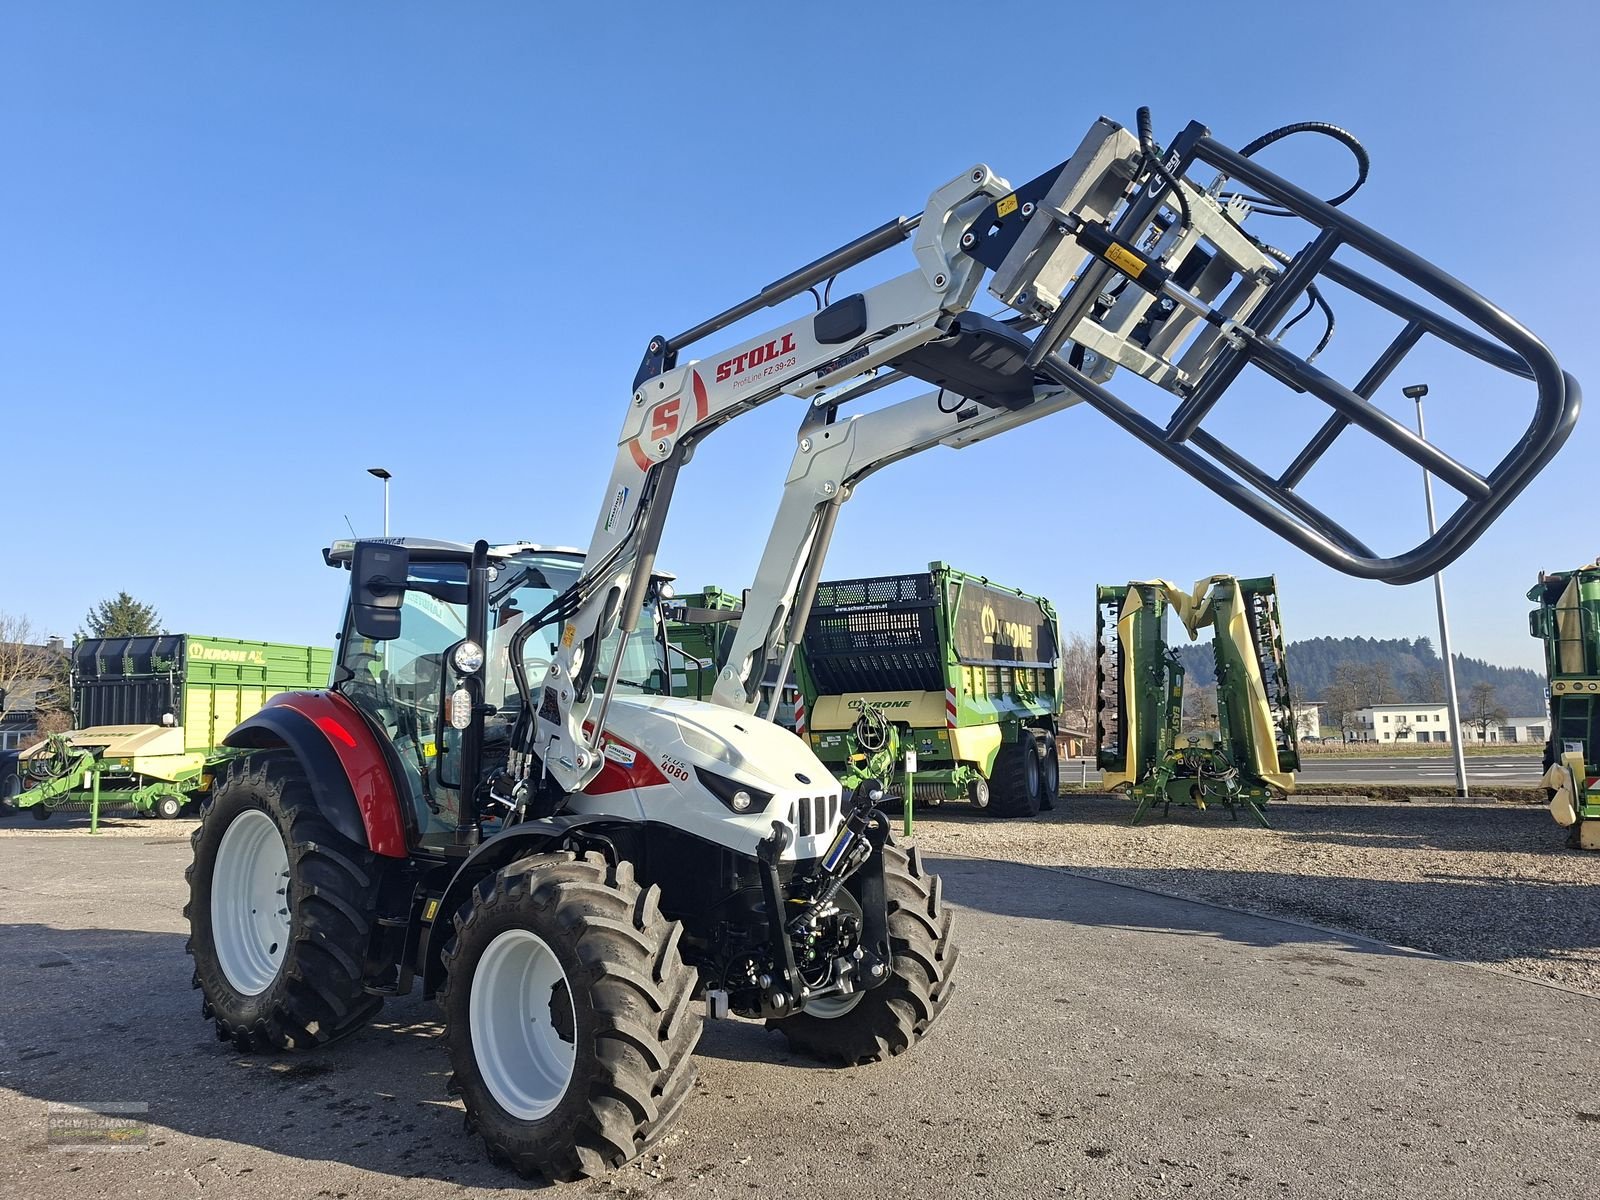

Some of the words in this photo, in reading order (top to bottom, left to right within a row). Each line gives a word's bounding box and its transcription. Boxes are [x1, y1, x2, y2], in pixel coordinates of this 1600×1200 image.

[716, 332, 796, 383] STOLL
[763, 368, 773, 378] FZ
[774, 356, 796, 372] 39-23
[651, 398, 680, 442] S
[996, 619, 1032, 648] KRONE
[203, 648, 248, 662] KRONE
[1172, 705, 1181, 732] EASY
[661, 753, 686, 769] PLUS
[661, 760, 689, 782] 4080
